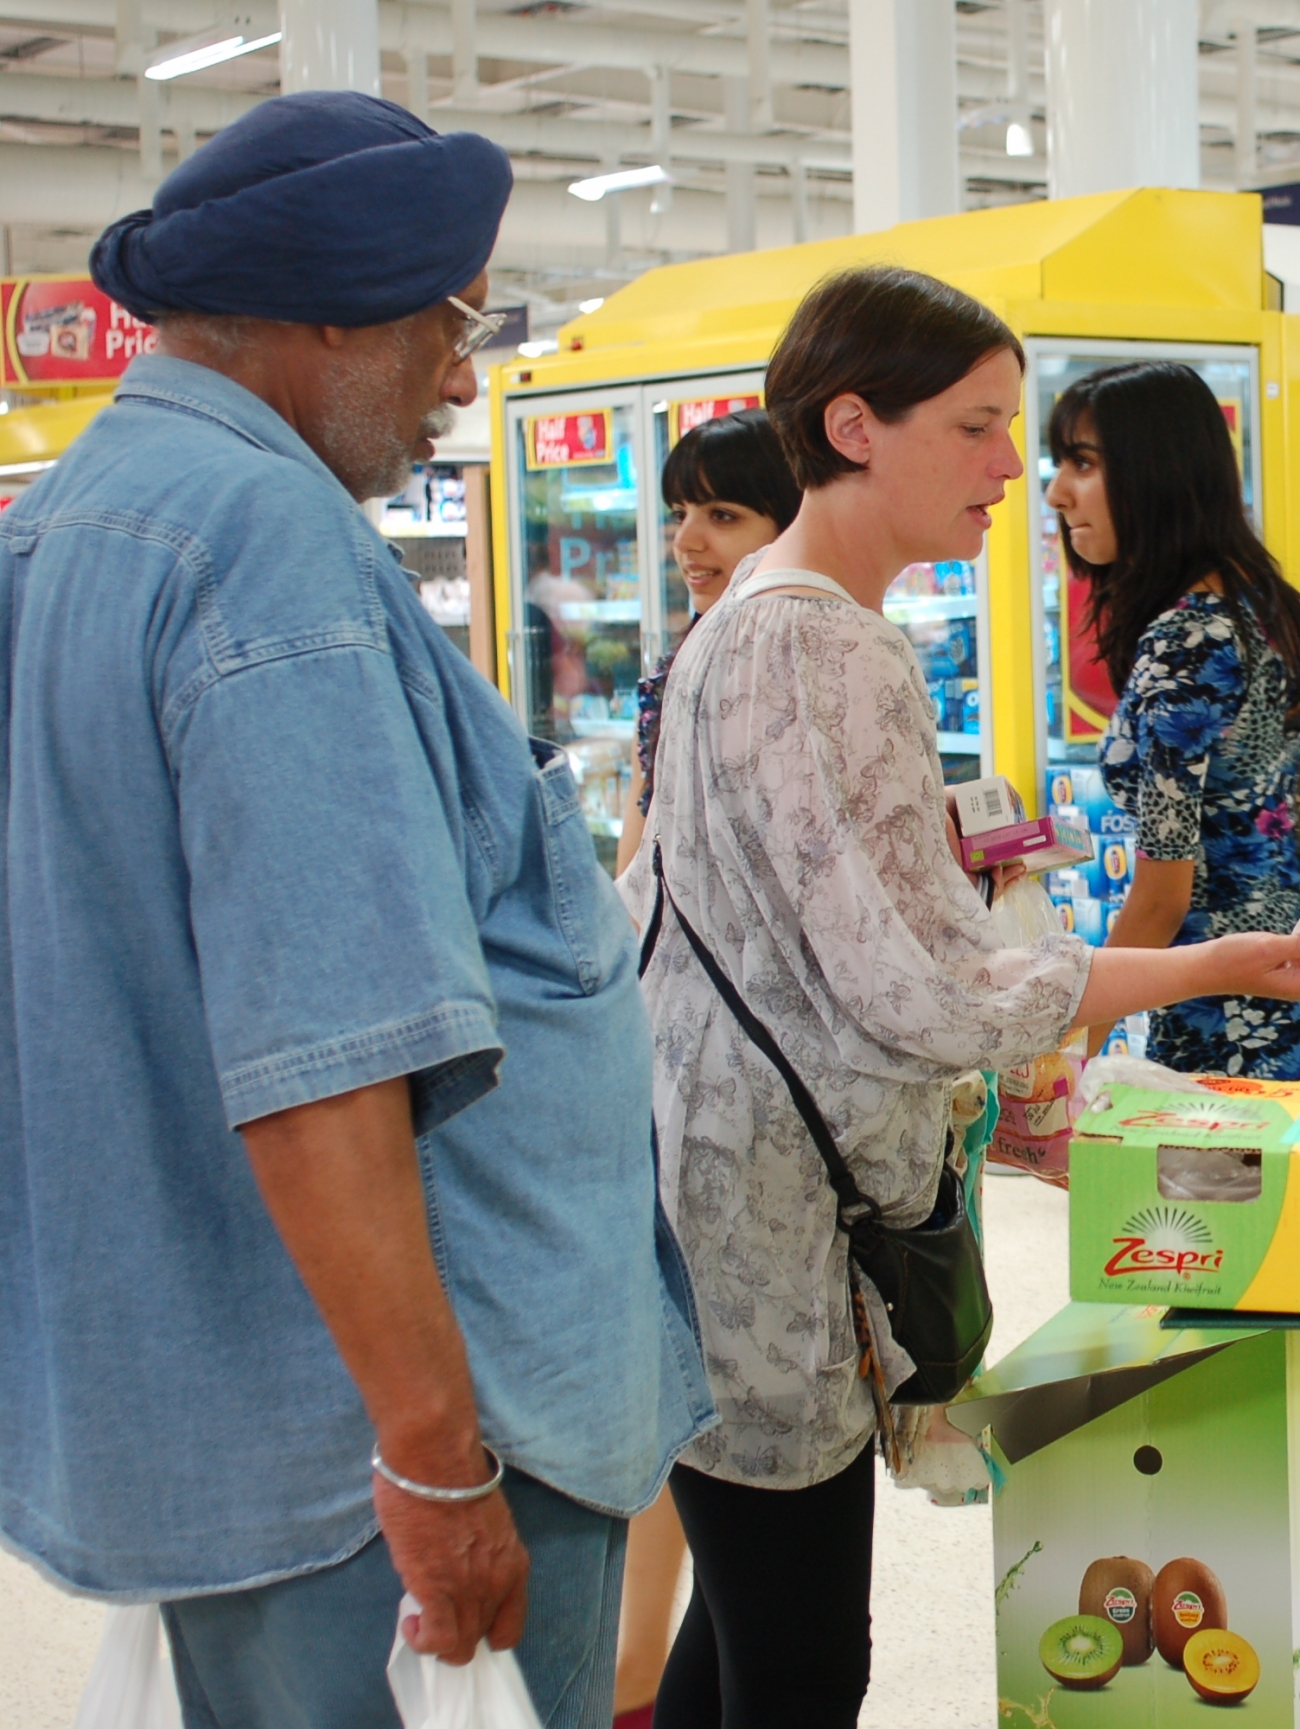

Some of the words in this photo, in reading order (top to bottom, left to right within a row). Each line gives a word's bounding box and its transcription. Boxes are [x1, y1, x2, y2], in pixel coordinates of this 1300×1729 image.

[110, 301, 150, 330] Ha
[105, 329, 160, 360] Pric
[538, 415, 567, 441] Half
[535, 442, 570, 465] Price
[1103, 1237, 1224, 1277] Zespri
[1098, 1278, 1123, 1290] New
[1126, 1279, 1171, 1293] Zealand
[1174, 1282, 1222, 1297] Kiwifruit
